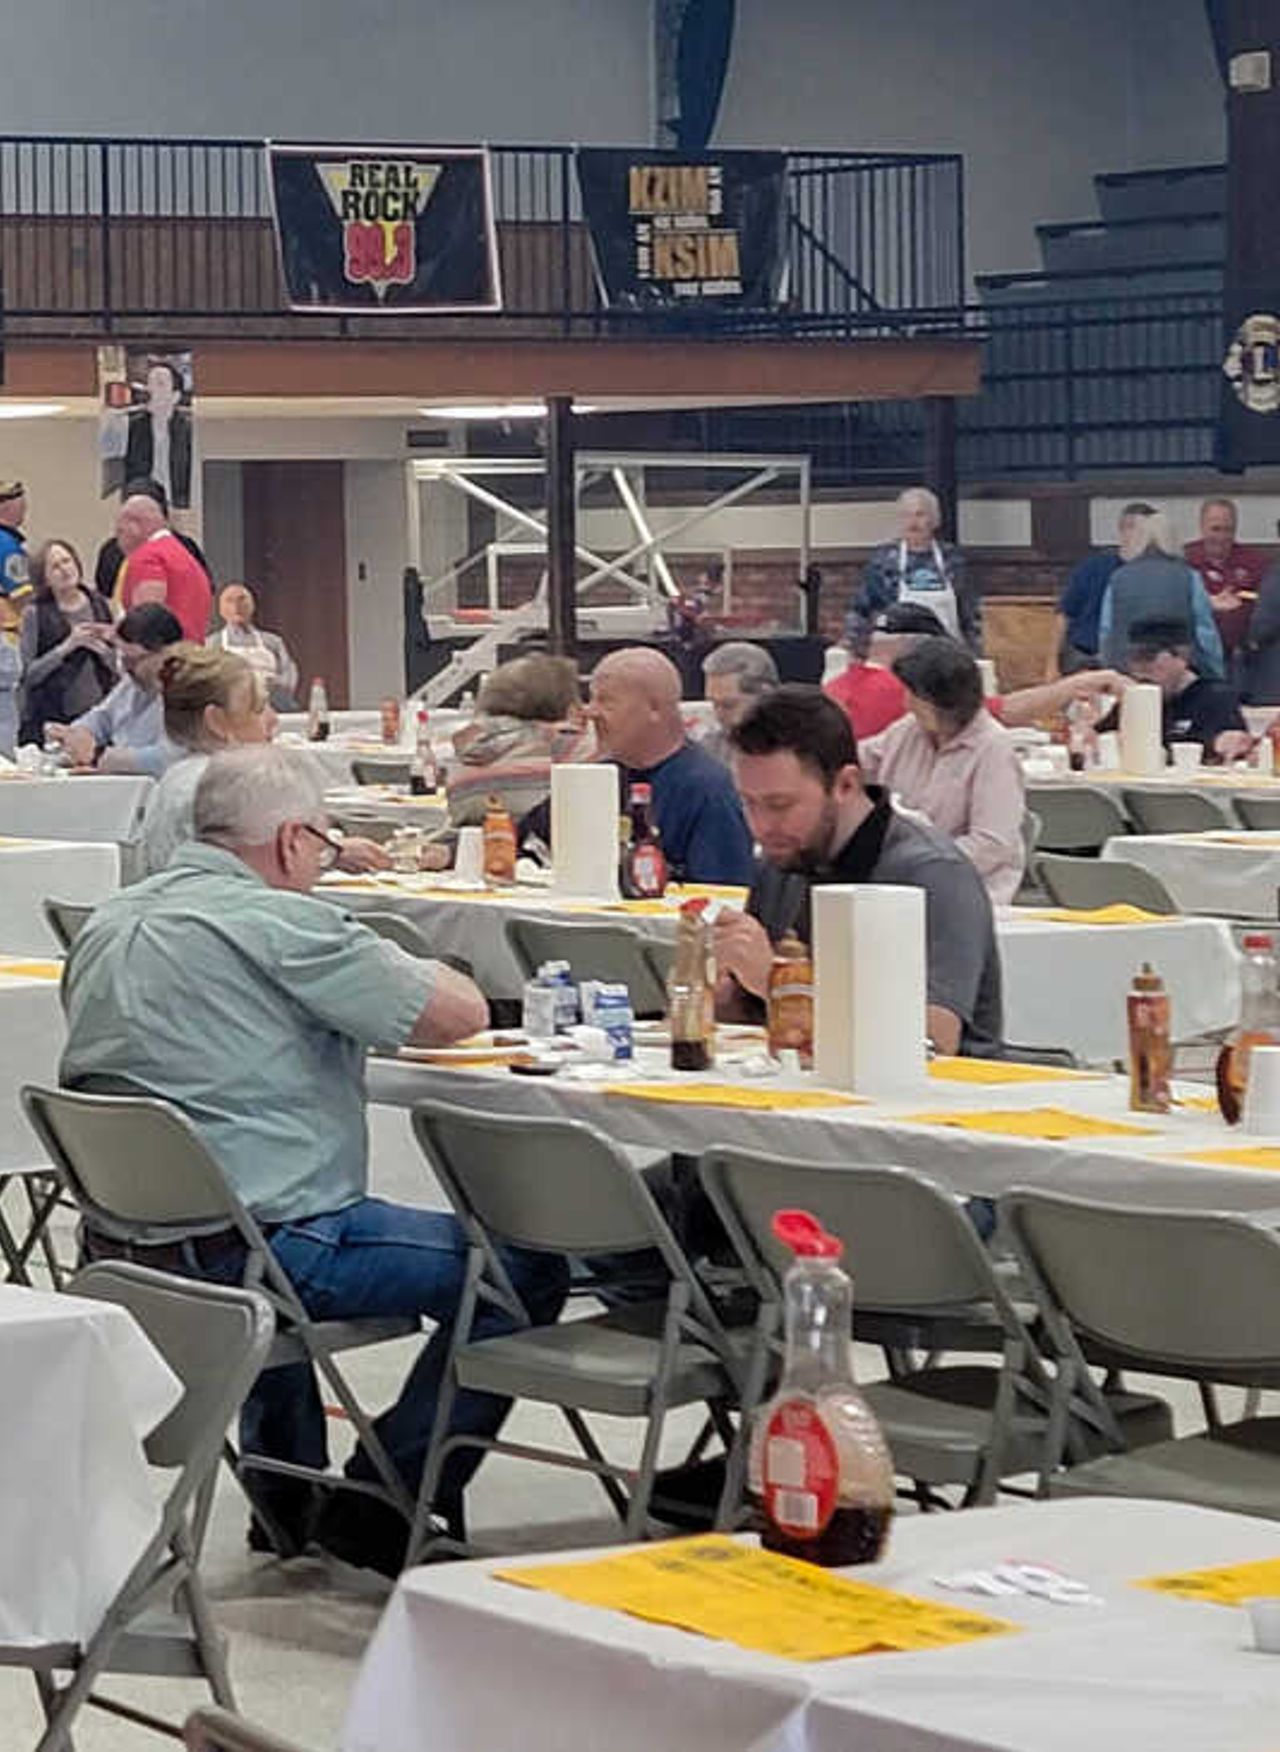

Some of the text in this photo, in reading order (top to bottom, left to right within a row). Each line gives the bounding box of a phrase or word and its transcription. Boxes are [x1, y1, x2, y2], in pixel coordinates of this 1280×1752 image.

[349, 163, 418, 188] REAL
[341, 190, 421, 221] ROCK
[654, 233, 741, 279] KSIM
